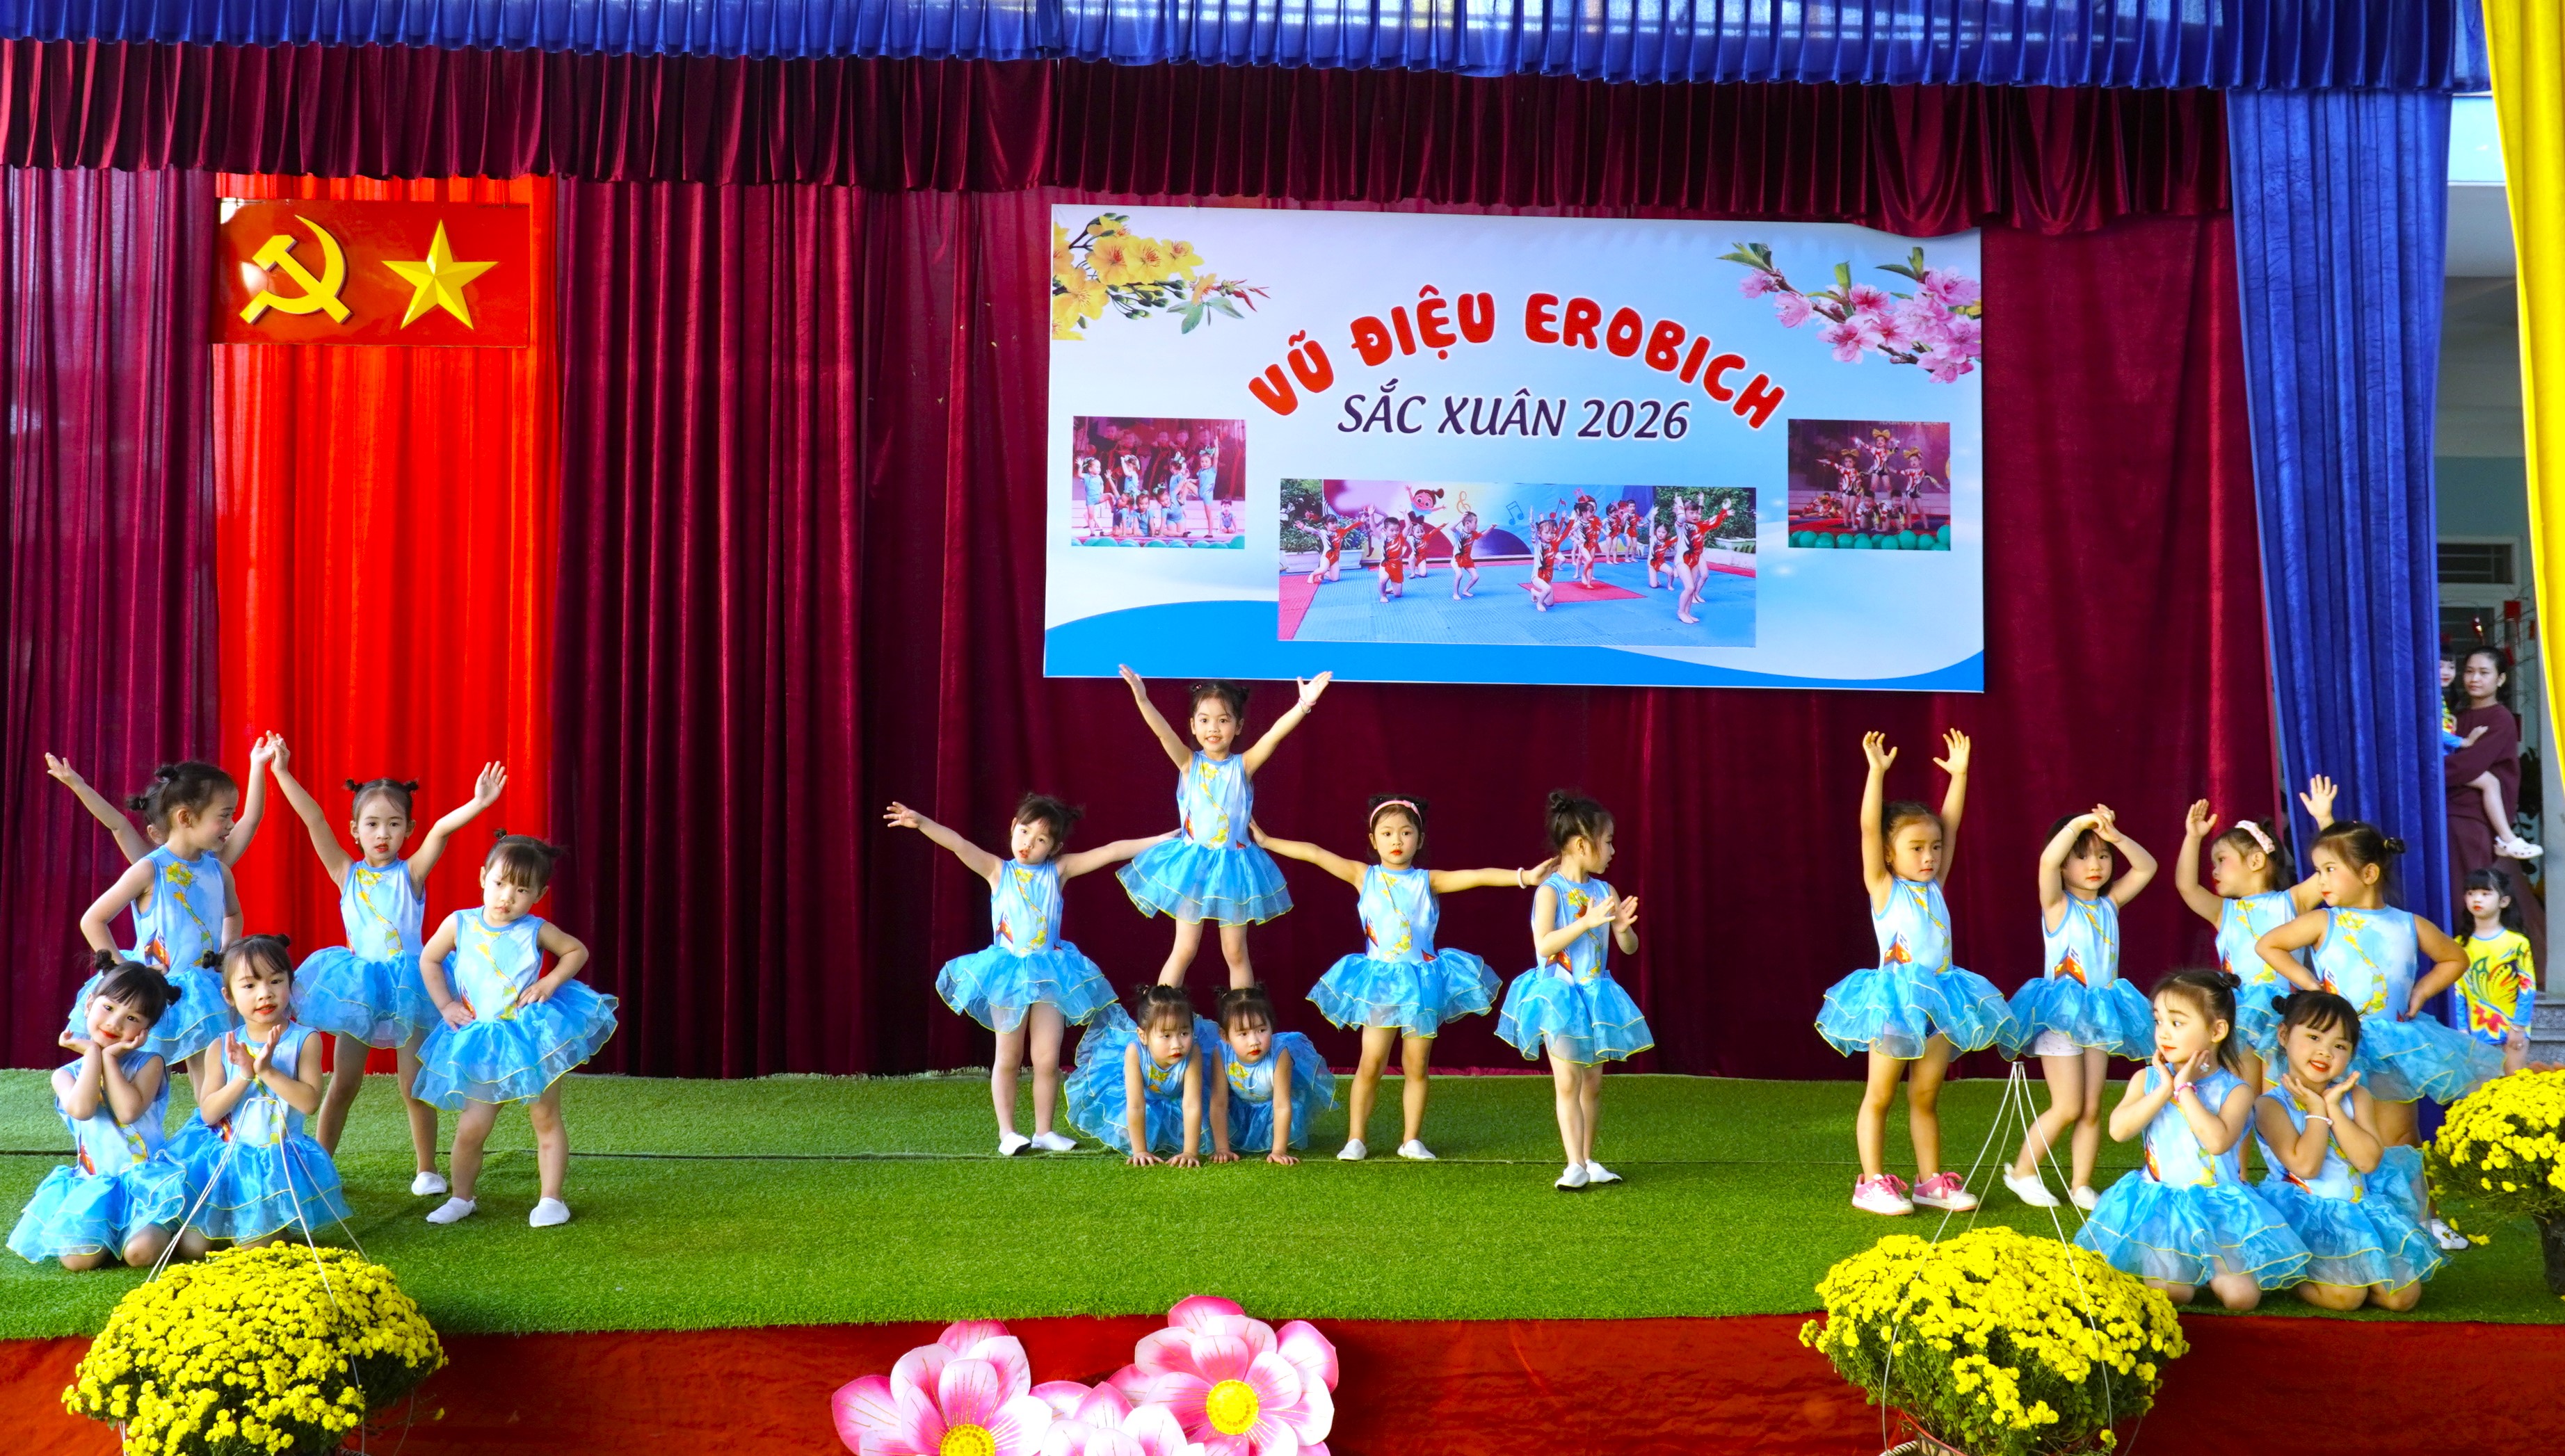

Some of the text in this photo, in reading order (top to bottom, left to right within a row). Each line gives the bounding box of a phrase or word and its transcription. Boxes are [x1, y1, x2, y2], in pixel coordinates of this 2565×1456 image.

[1248, 284, 1785, 430] VŨ ĐIỆU EROBICH
[1337, 378, 1691, 439] SẮC XUÂN 2026
